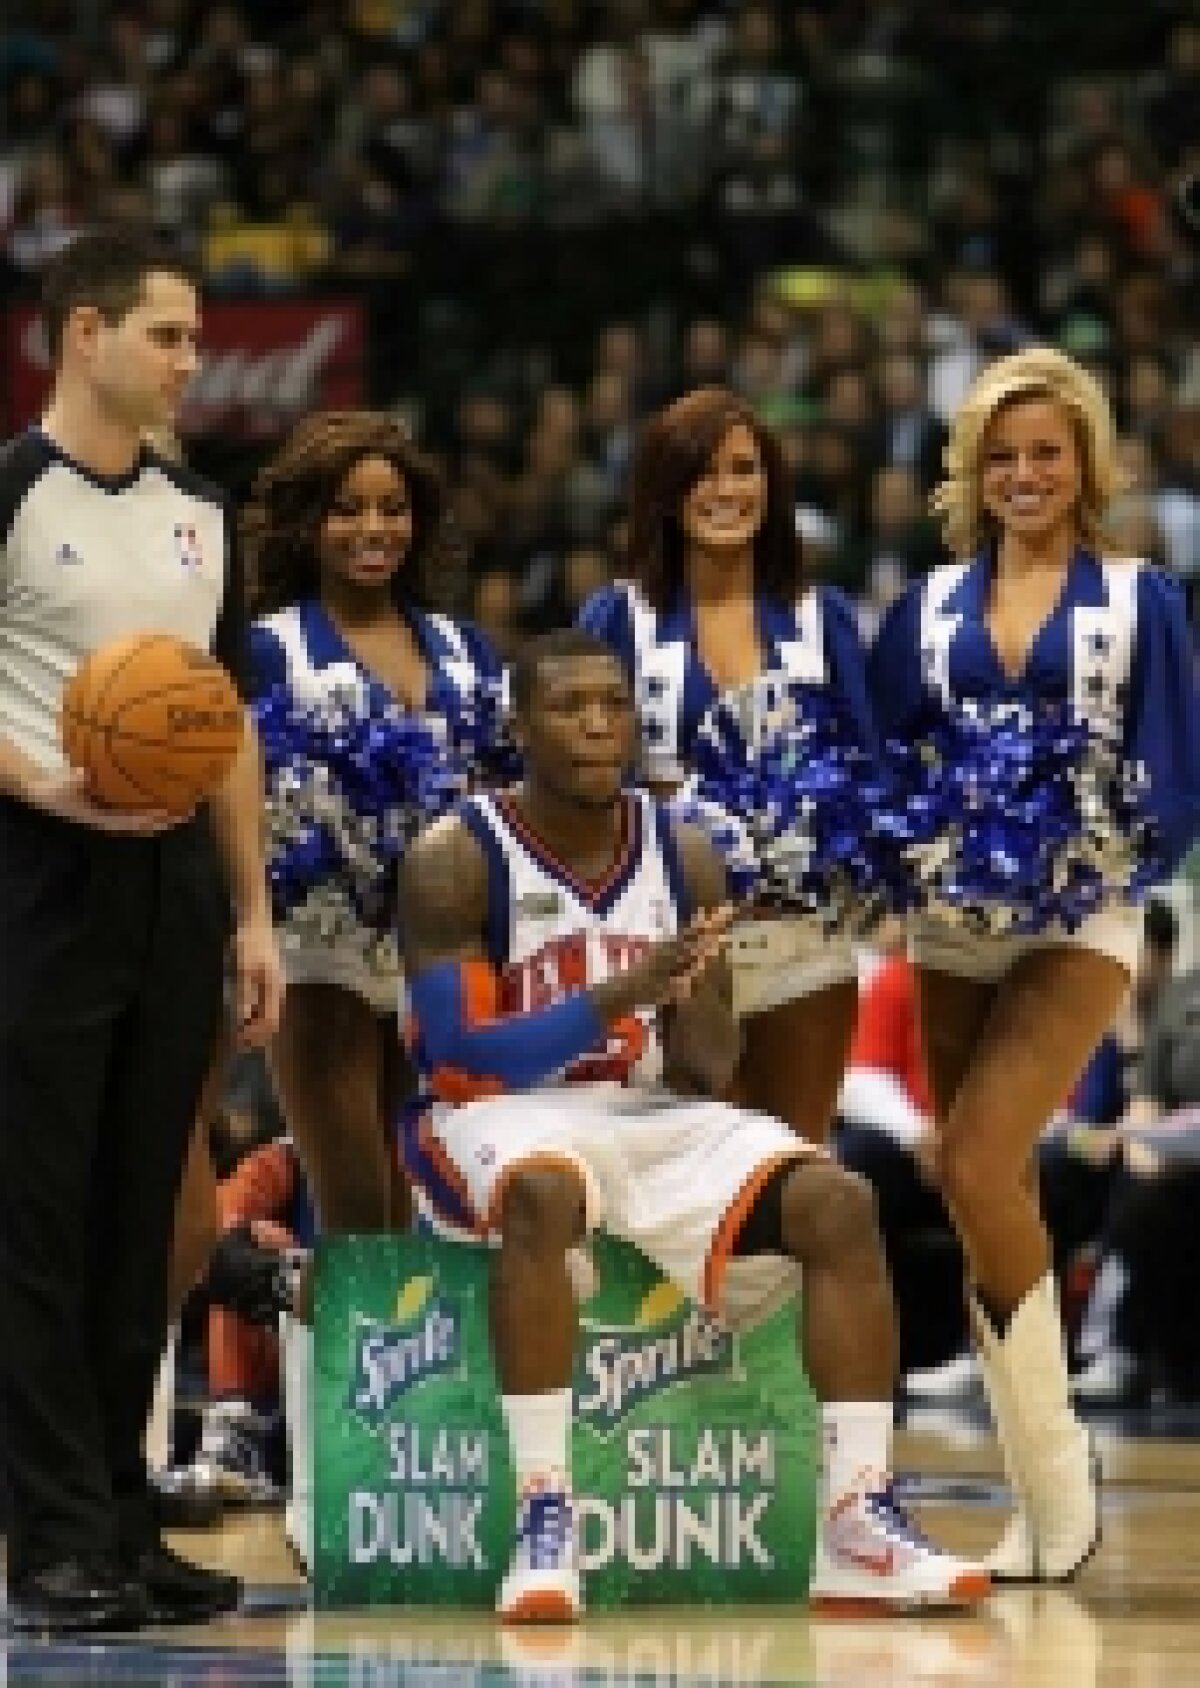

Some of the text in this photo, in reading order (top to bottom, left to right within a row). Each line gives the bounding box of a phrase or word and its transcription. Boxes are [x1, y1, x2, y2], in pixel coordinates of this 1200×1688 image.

[578, 1308, 726, 1414] Sprite
[389, 1429, 489, 1480] SLAM
[627, 1429, 776, 1487] SLAM
[354, 1492, 488, 1570] DUNK
